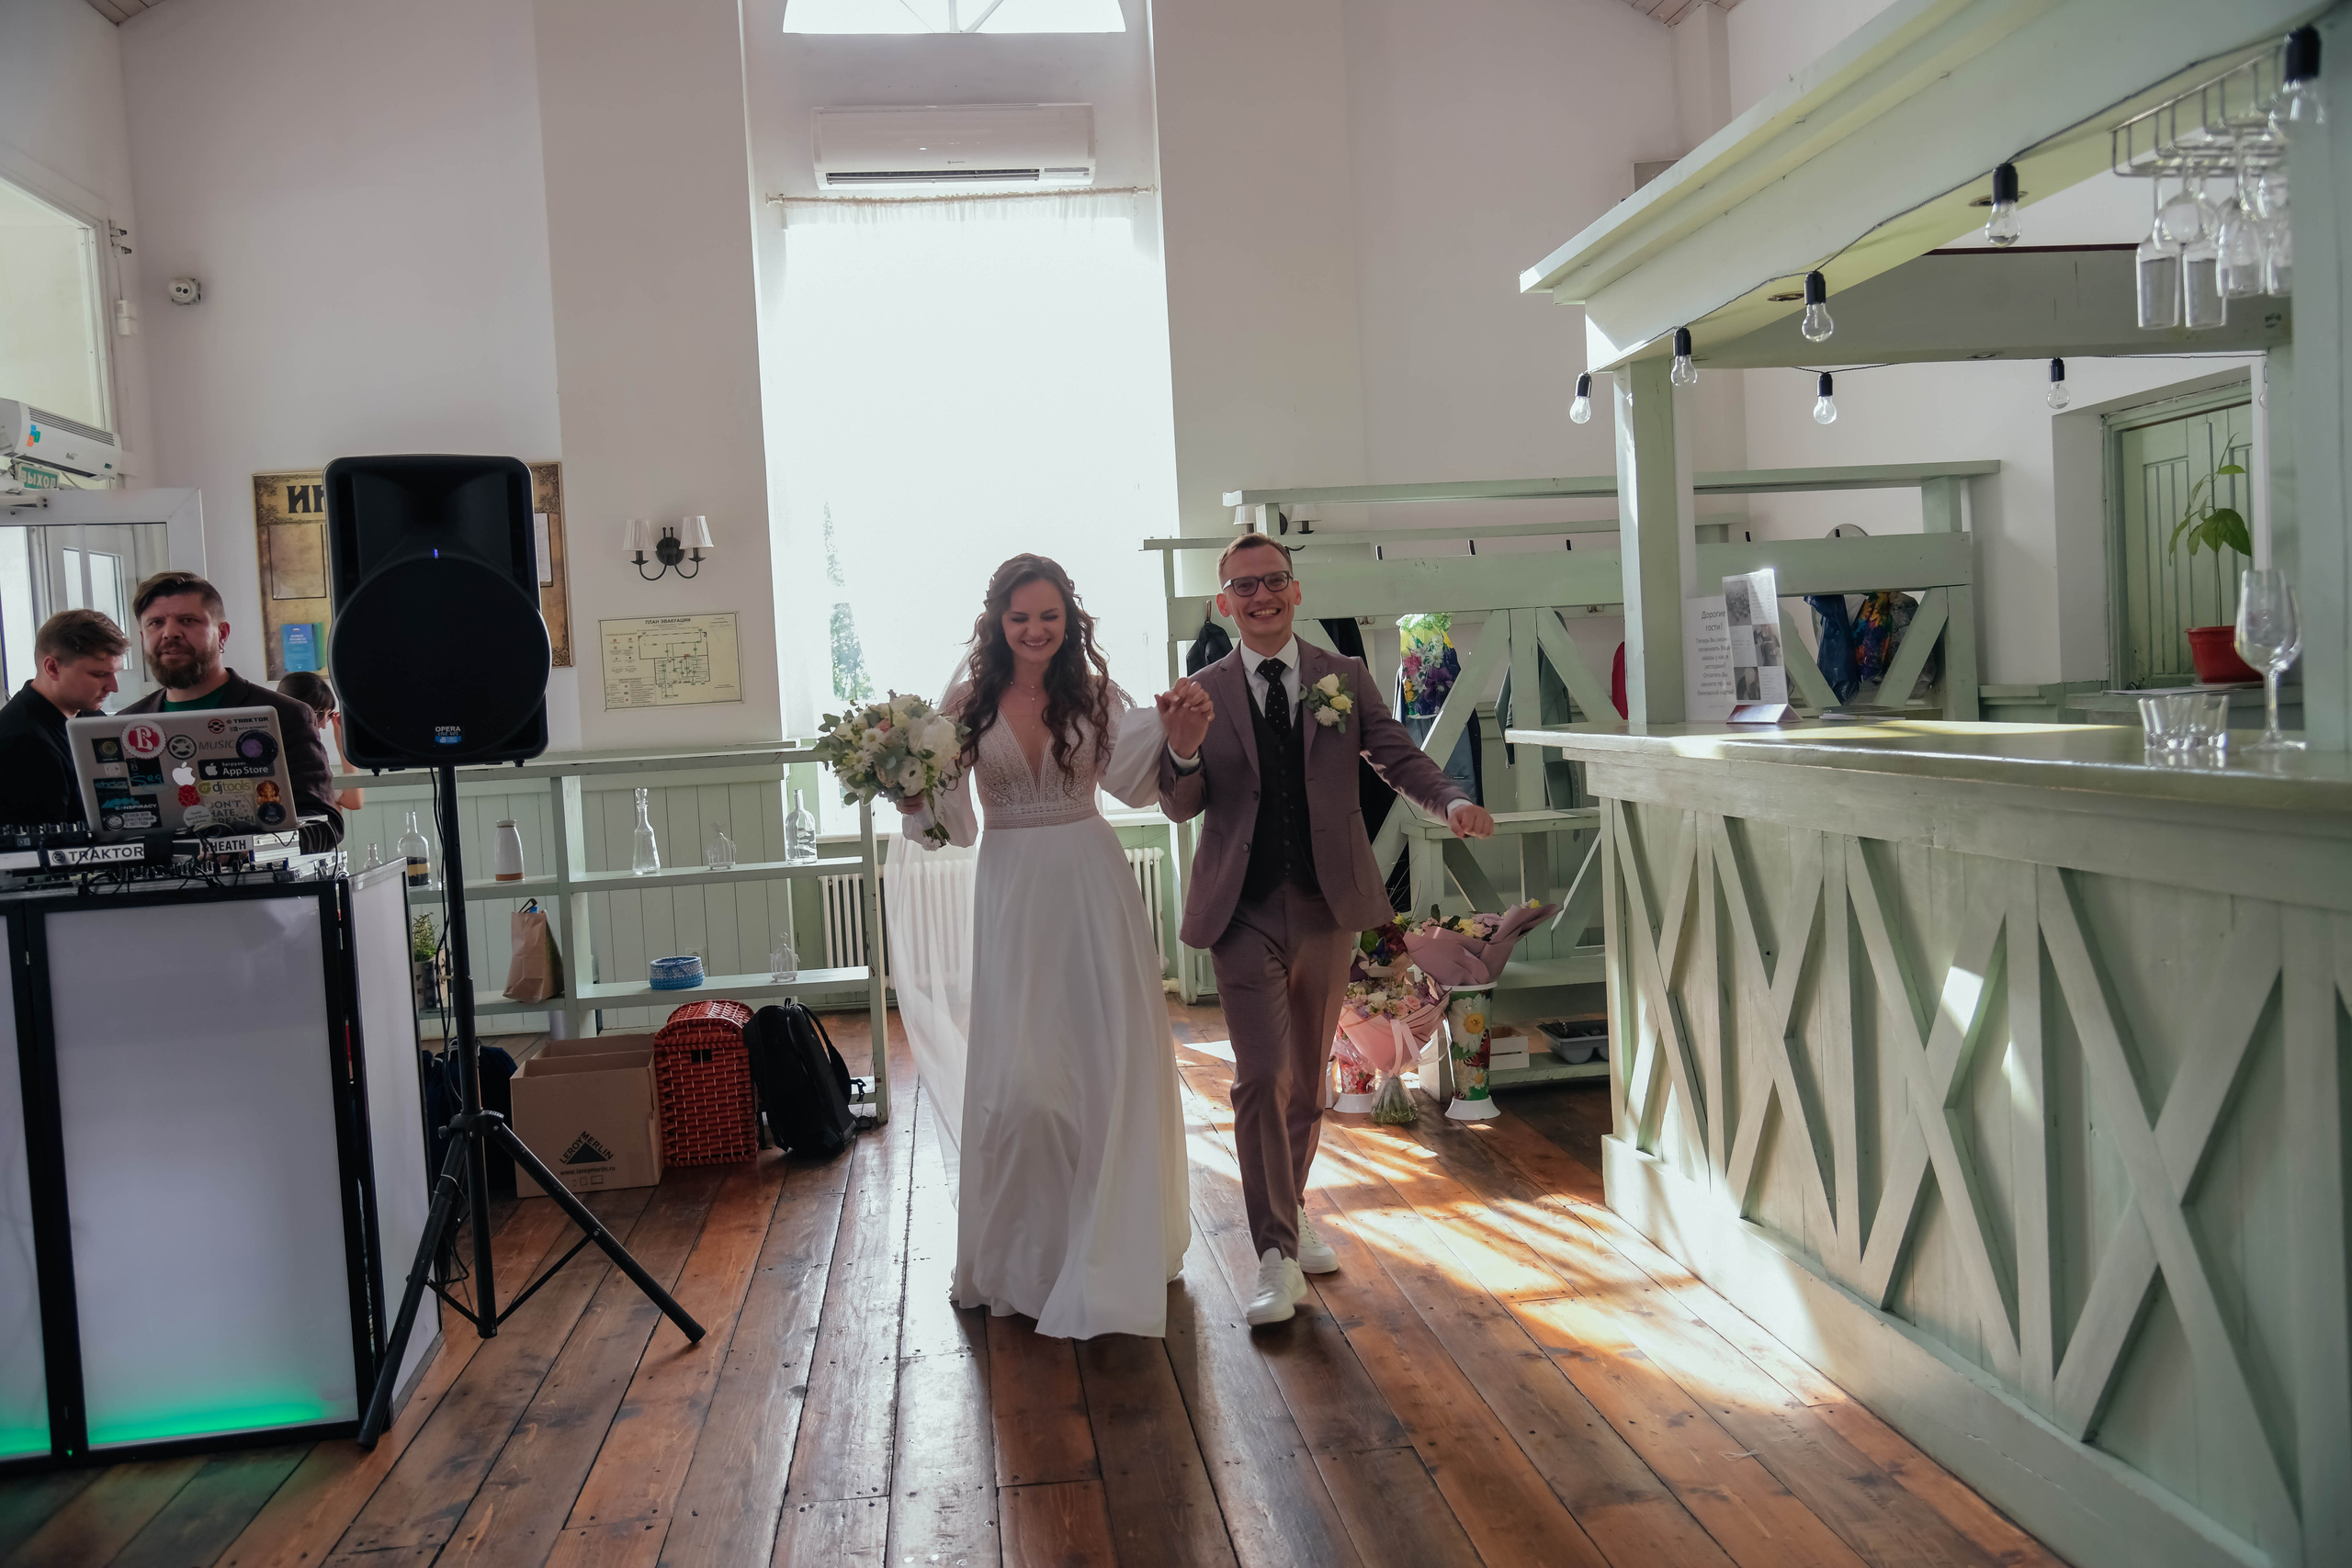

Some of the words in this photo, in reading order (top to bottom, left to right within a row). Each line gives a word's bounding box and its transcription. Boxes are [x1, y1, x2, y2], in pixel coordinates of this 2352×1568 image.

[1702, 610, 1726, 620] Дорогие
[198, 739, 235, 750] MUSIC
[222, 767, 243, 776] App
[243, 765, 269, 774] Store
[69, 846, 144, 862] TRAKTOR
[559, 1137, 583, 1164] LEROY
[580, 1131, 615, 1161] MERLIN
